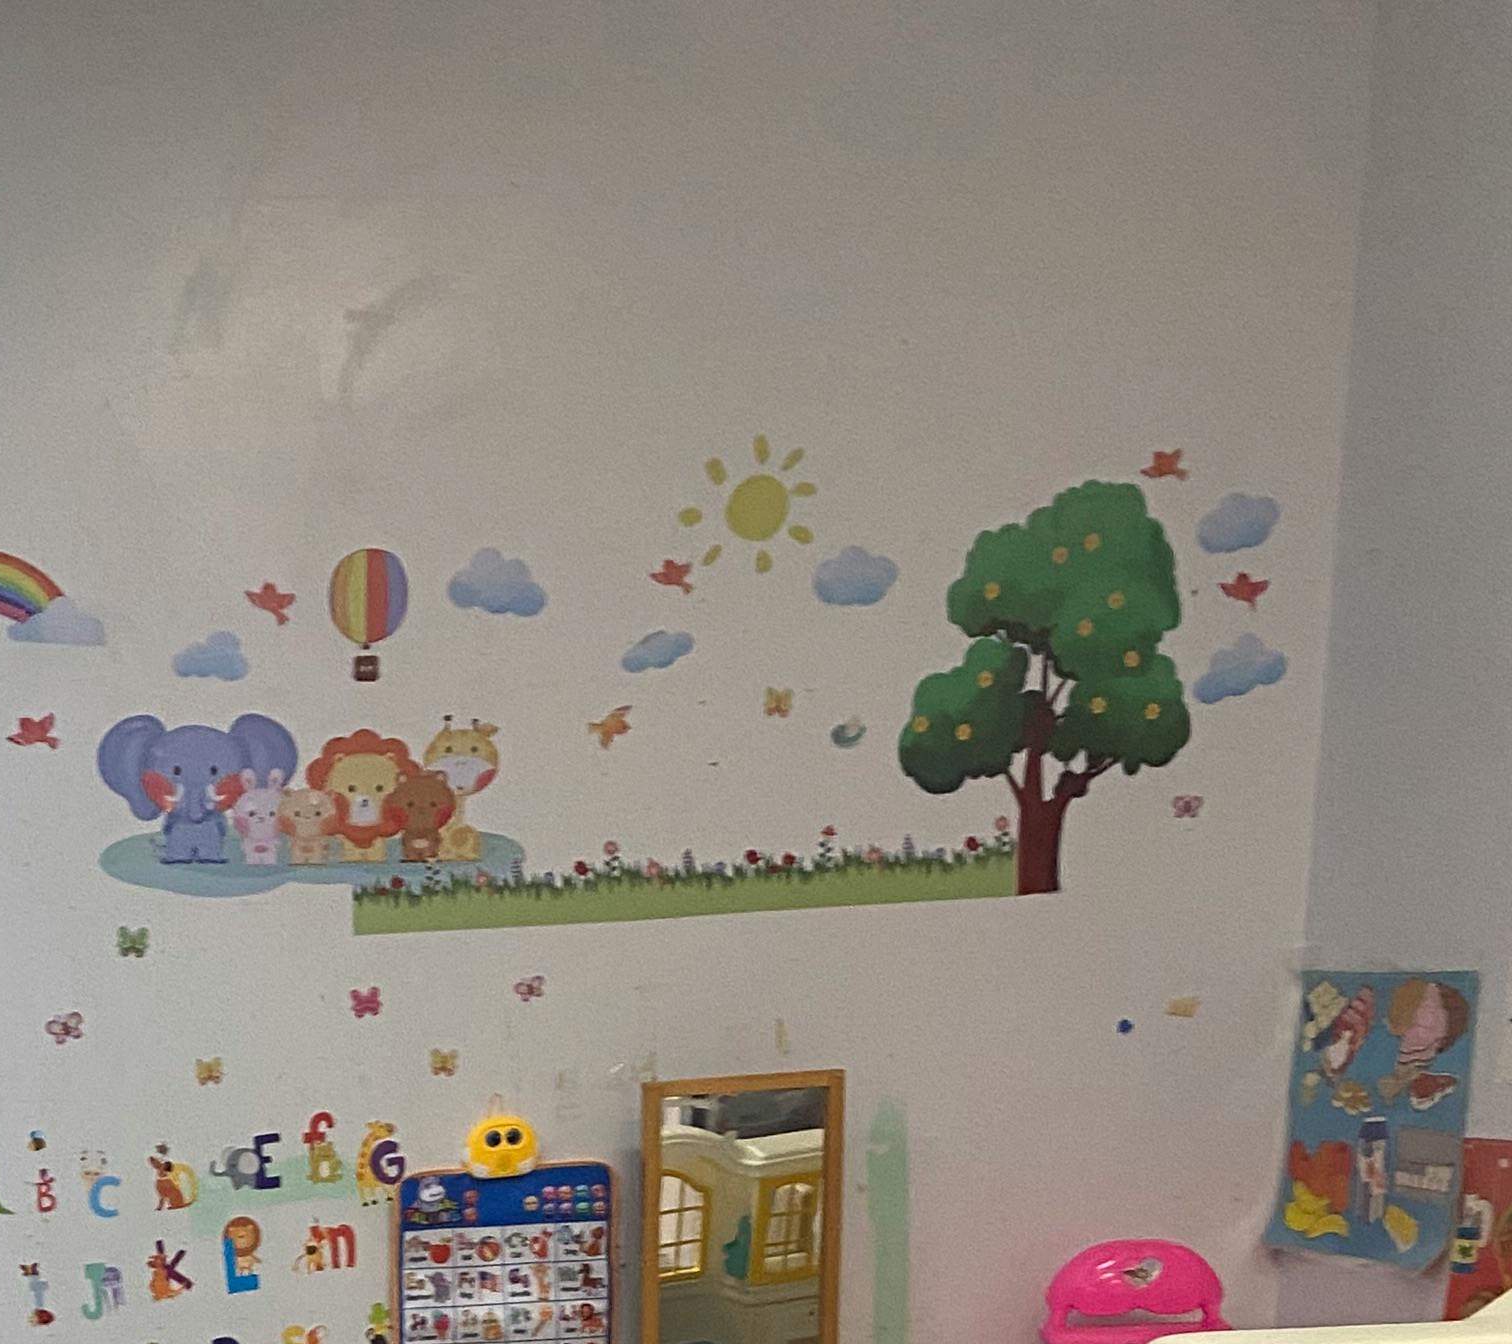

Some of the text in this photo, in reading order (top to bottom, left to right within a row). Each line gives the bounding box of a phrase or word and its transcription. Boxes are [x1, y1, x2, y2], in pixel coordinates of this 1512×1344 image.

[89, 1175, 121, 1218] C
[254, 1132, 281, 1189] E
[370, 1140, 406, 1185] G
[155, 1239, 194, 1290] K
[223, 1238, 261, 1295] L
